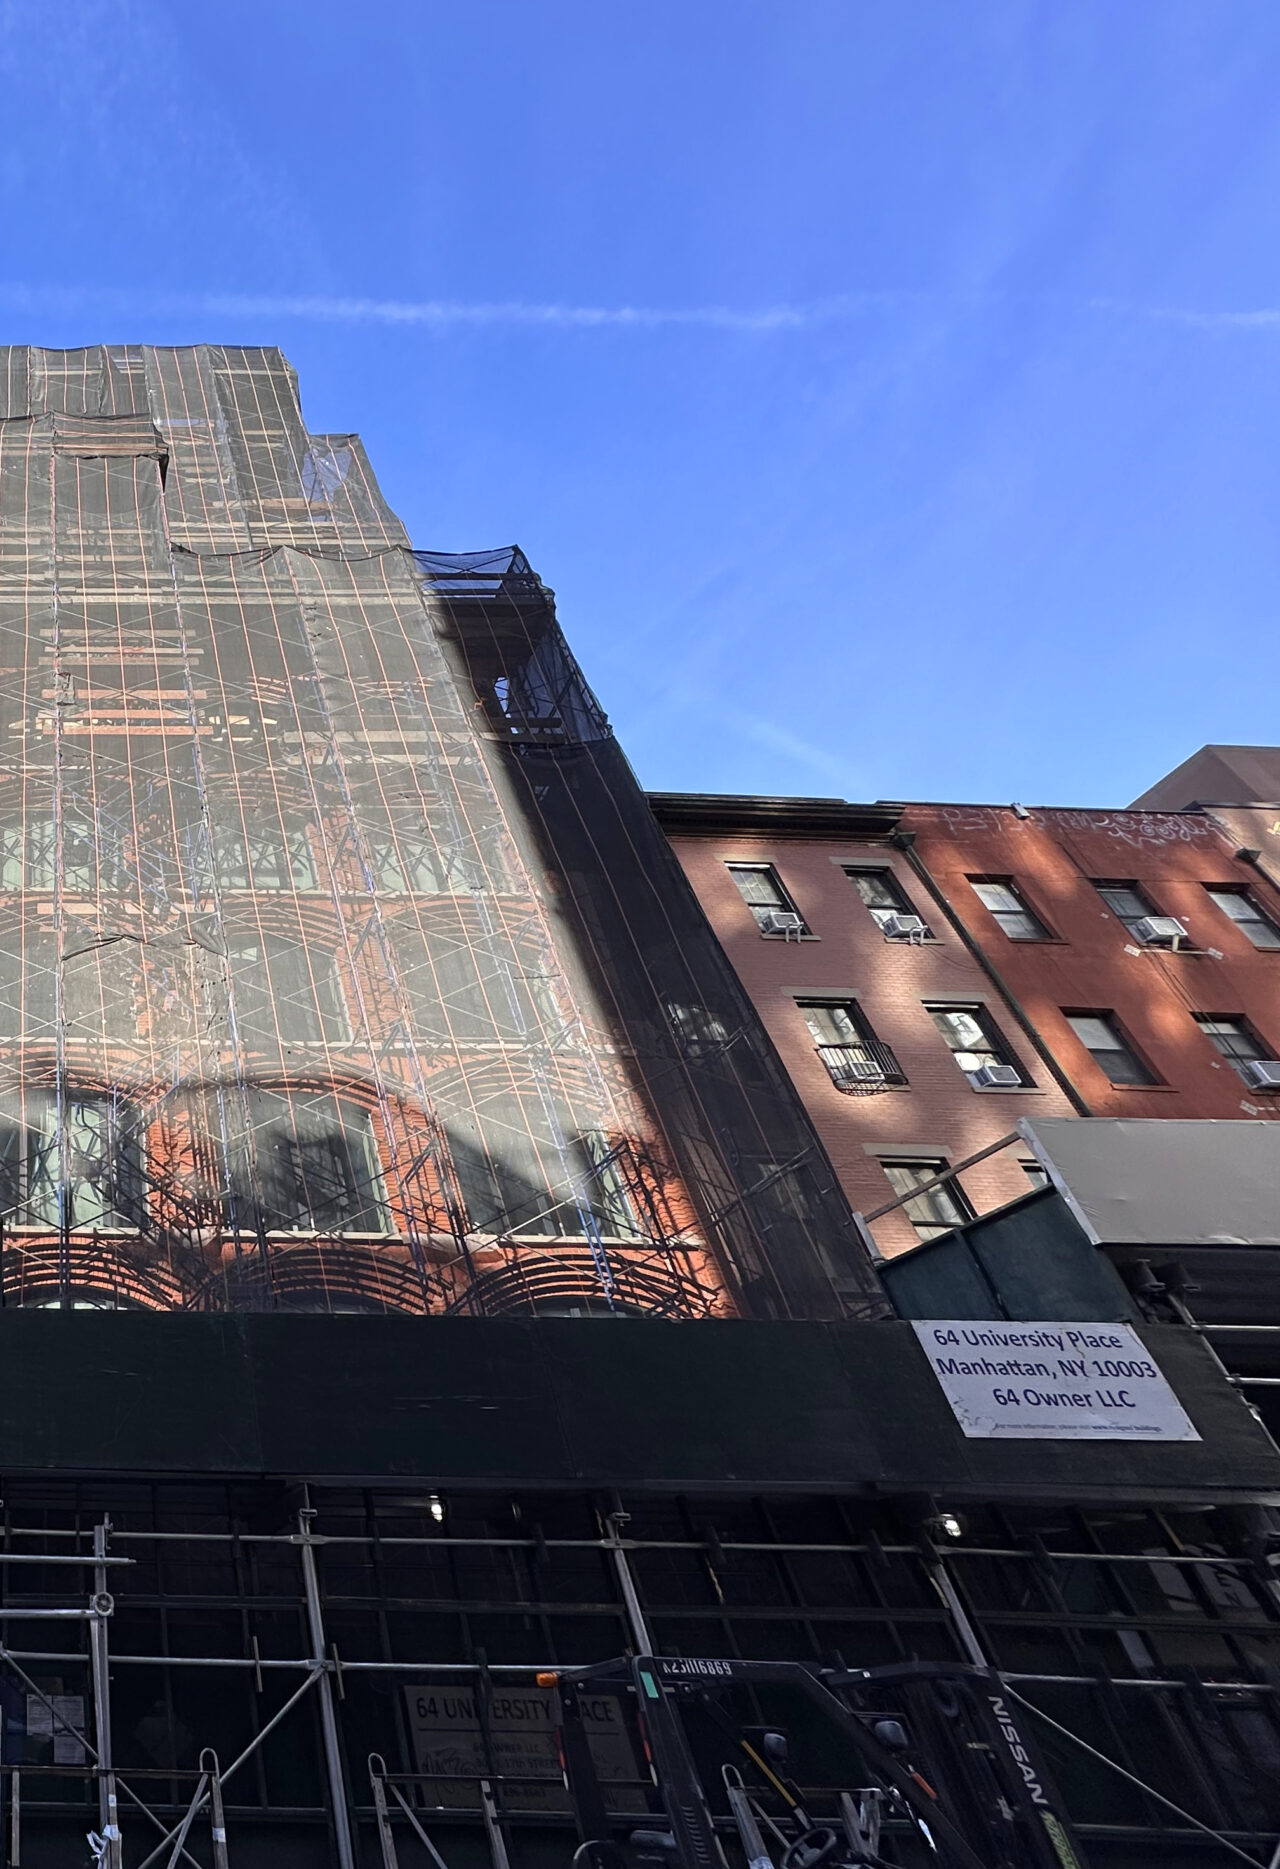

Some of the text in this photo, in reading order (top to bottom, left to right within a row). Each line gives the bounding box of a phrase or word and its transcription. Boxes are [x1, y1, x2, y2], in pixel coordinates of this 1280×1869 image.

[933, 1329, 1123, 1351] 64 University Place
[937, 1357, 1157, 1381] Manhattan, NY 10003
[992, 1388, 1136, 1408] 64 Owner LLC
[416, 1697, 439, 1719] 64
[443, 1698, 550, 1721] UNIERSITY
[987, 1695, 1049, 1806] NISSAN
